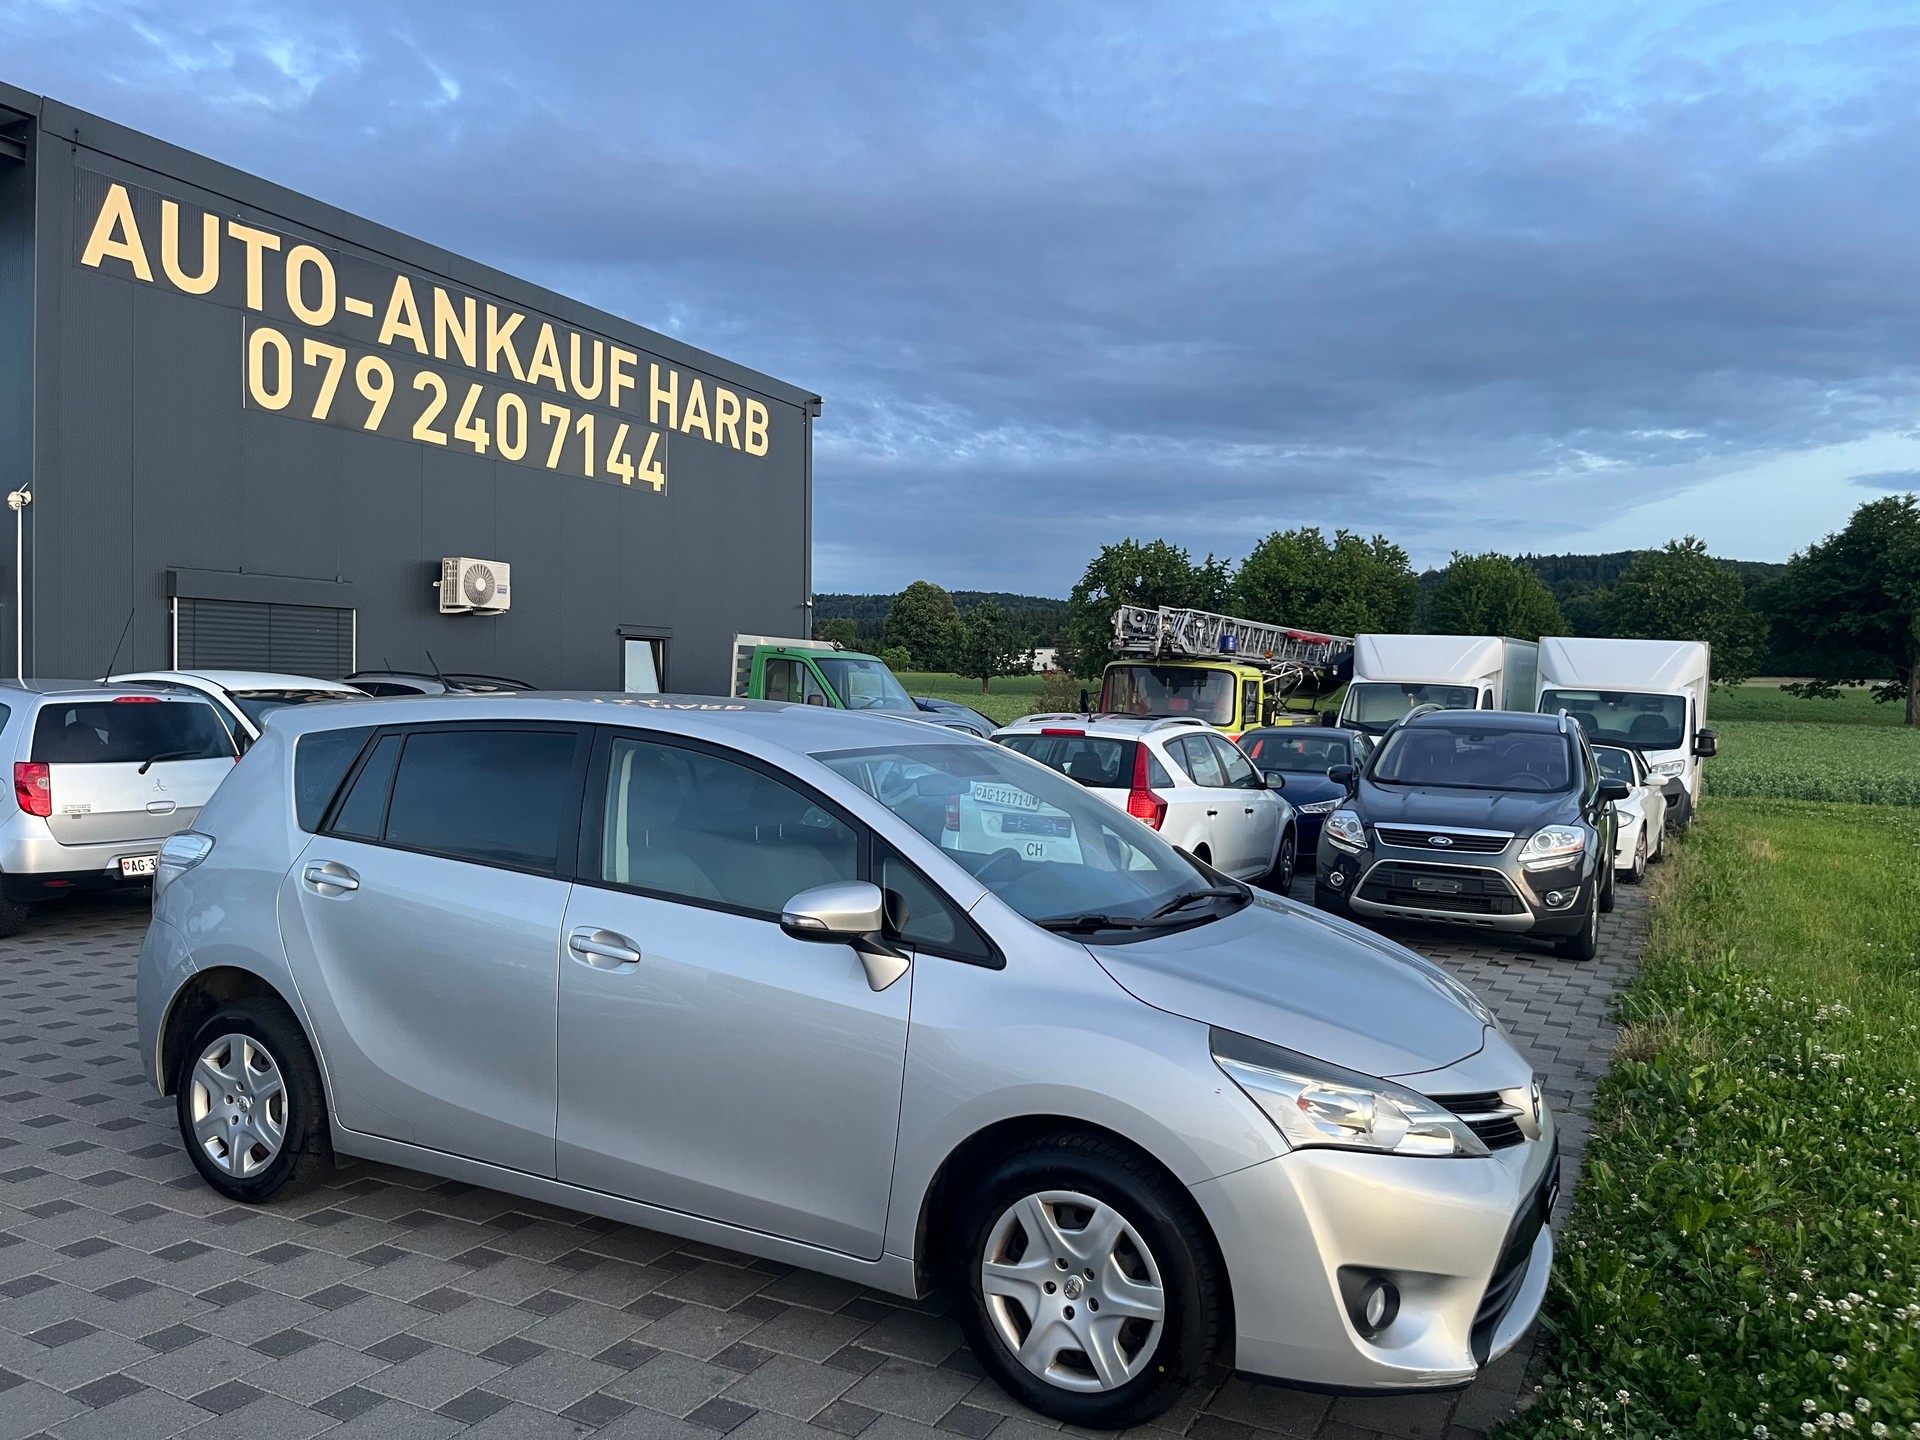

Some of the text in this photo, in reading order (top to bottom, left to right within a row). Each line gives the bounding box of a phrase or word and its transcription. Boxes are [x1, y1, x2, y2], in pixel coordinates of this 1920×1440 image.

[81, 183, 769, 457] AUTO-ANKAUF HARB
[248, 327, 395, 431] 079
[412, 370, 528, 461] 240
[1026, 842, 1043, 857] CH
